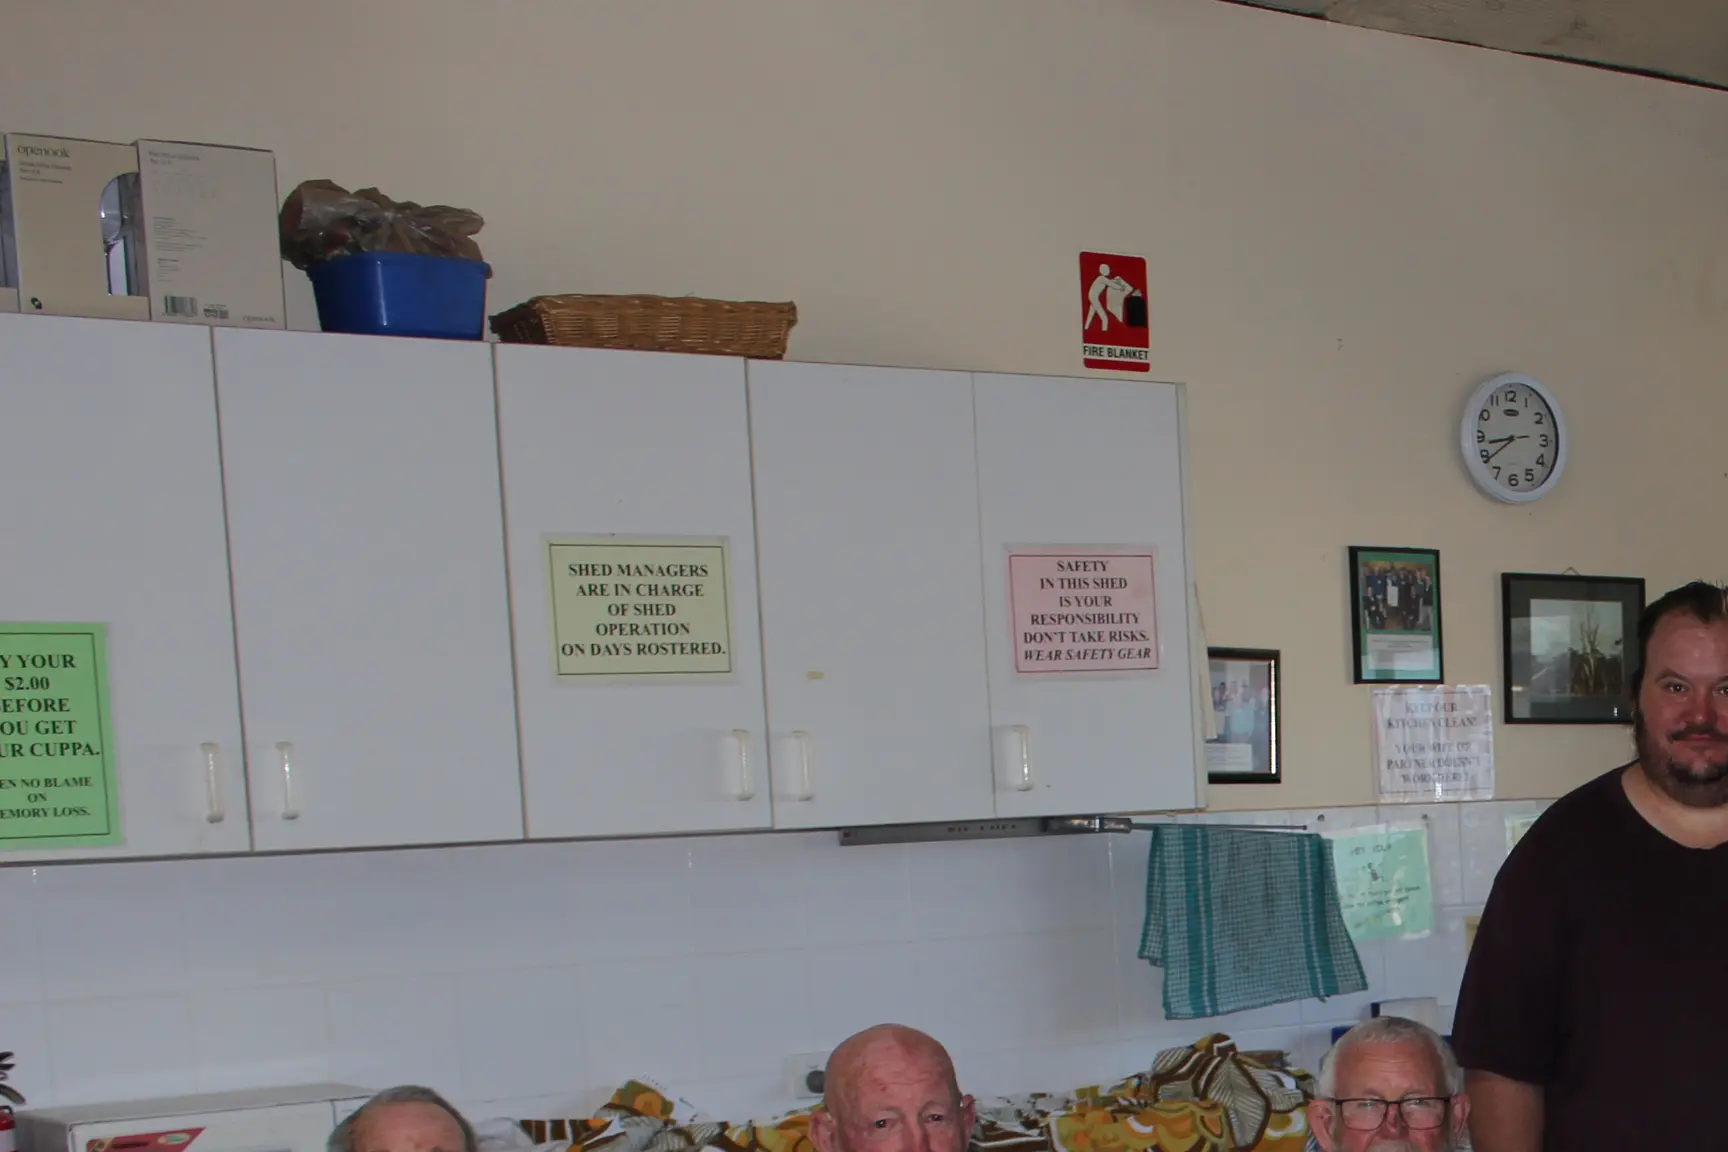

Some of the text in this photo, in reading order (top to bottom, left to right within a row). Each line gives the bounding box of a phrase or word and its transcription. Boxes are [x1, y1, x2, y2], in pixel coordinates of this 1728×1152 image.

[17, 145, 70, 158] openook
[1083, 345, 1149, 360] FIRE BLANKET
[1490, 394, 1499, 407] 11
[1505, 390, 1517, 403] 12
[1524, 397, 1529, 408] 1
[1534, 412, 1544, 425] 2
[1477, 429, 1486, 443] 9
[1539, 434, 1549, 448] 3
[1480, 449, 1491, 464] 8
[1535, 453, 1545, 467] 4
[1492, 466, 1501, 480] 7
[1524, 468, 1534, 482] 5
[1508, 474, 1519, 487] 6
[568, 563, 708, 577] SHED MANAGERS
[1056, 561, 1109, 573] SAFETY
[1040, 577, 1128, 590] IN THIS SHED
[576, 584, 704, 597] ARE IN CHARGE
[1059, 595, 1112, 607] IS YOUR
[607, 603, 676, 617] OF SHED
[1031, 613, 1140, 626] RESPONSIBILITY
[595, 623, 690, 636] OPERATION
[1023, 631, 1150, 644] DON'T TAKE RISKS.
[561, 642, 727, 657] ON DAYS ROSTERED.
[1024, 648, 1152, 661] WEAR SAFETY GEAR
[0, 654, 77, 669] Y YOUR
[0, 698, 71, 713] EFORE
[0, 720, 76, 736] OU GET
[0, 742, 100, 757] UR CUPPA.
[0, 776, 92, 789] EN NO BLAME
[27, 792, 47, 803] ON
[0, 806, 91, 819] EMORY LOSS.
